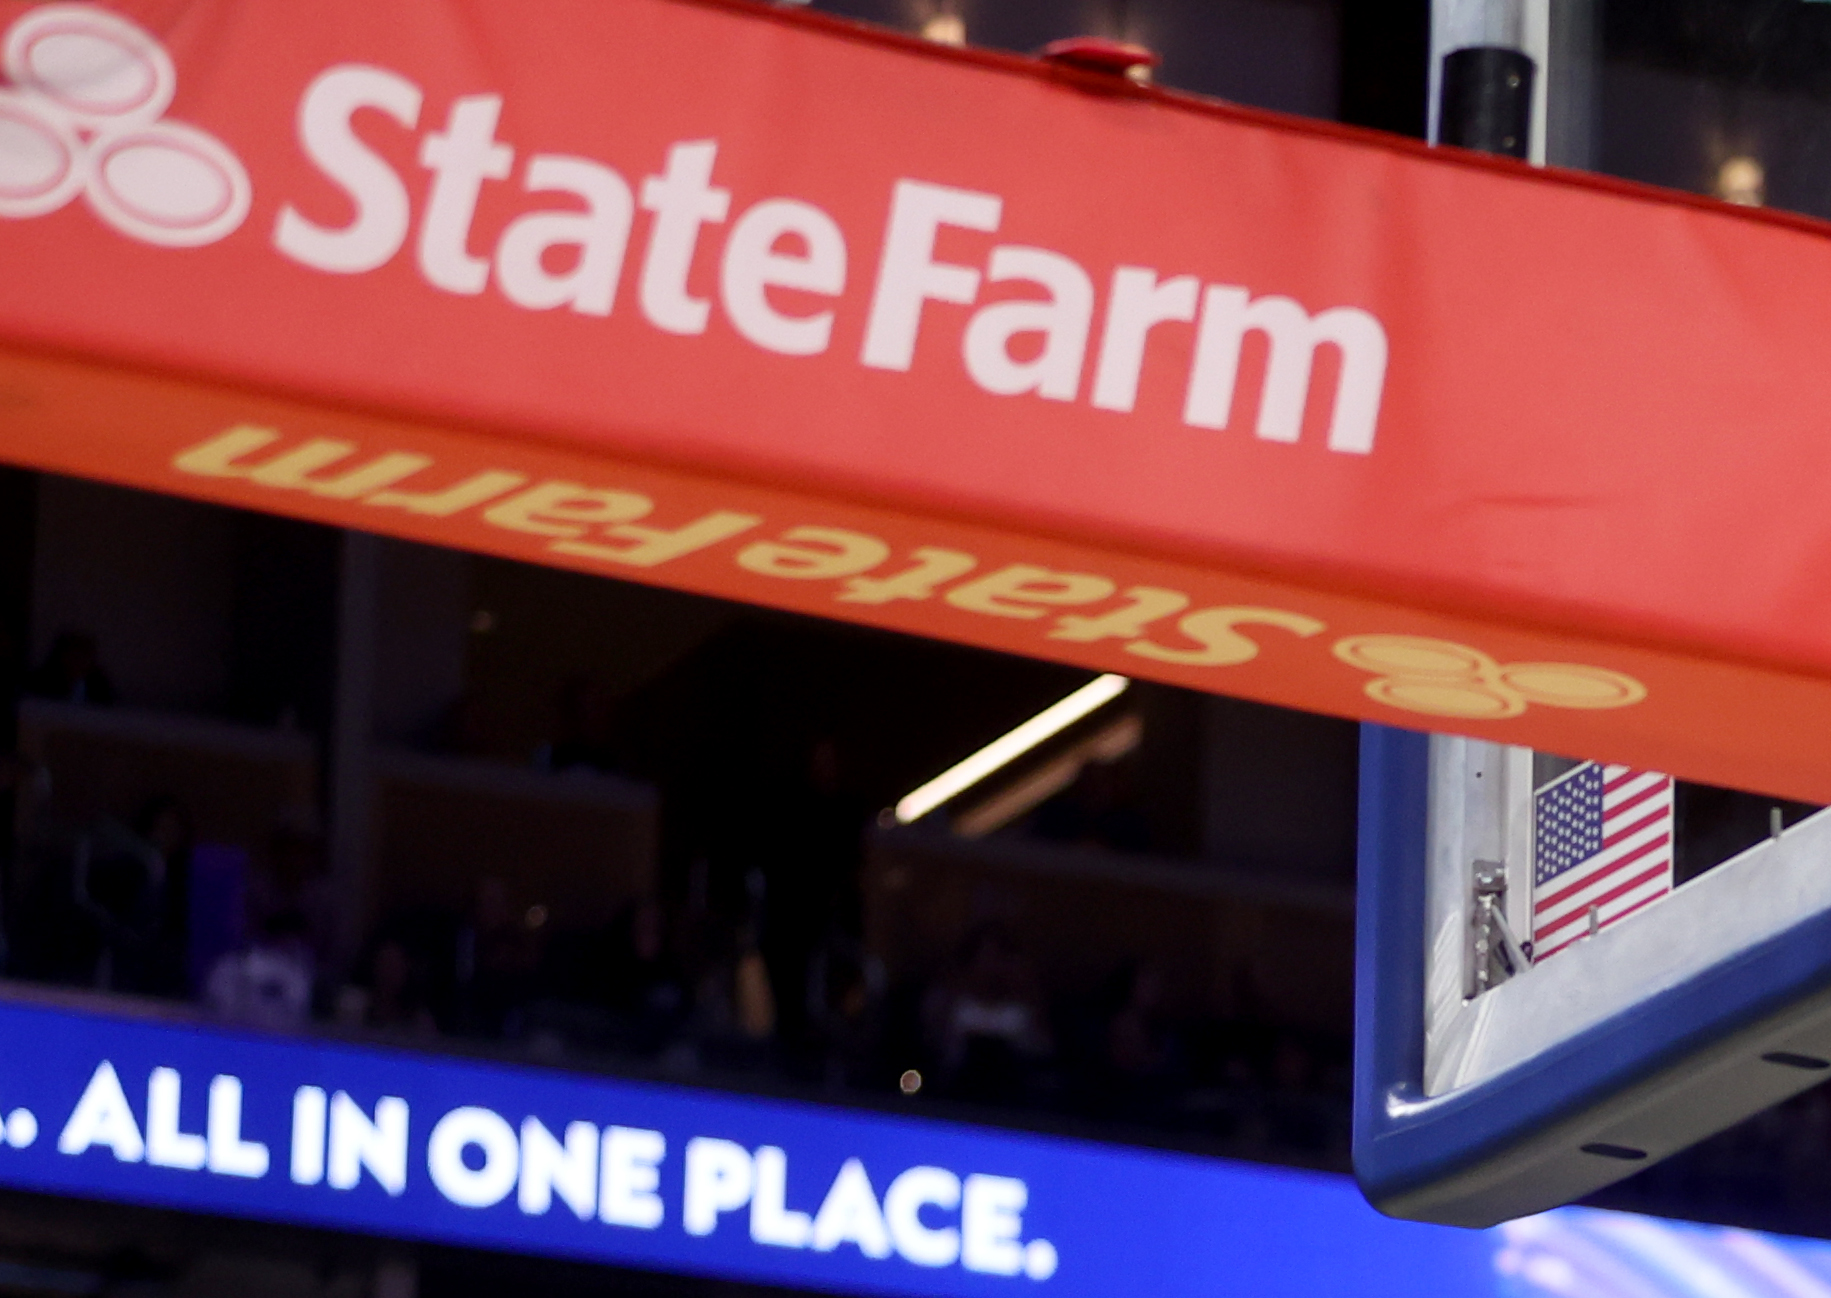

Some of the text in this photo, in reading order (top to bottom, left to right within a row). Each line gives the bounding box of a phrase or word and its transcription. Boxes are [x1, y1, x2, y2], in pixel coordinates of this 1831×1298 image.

[57, 1060, 1058, 1280] ALL IN ONE PLACE.
